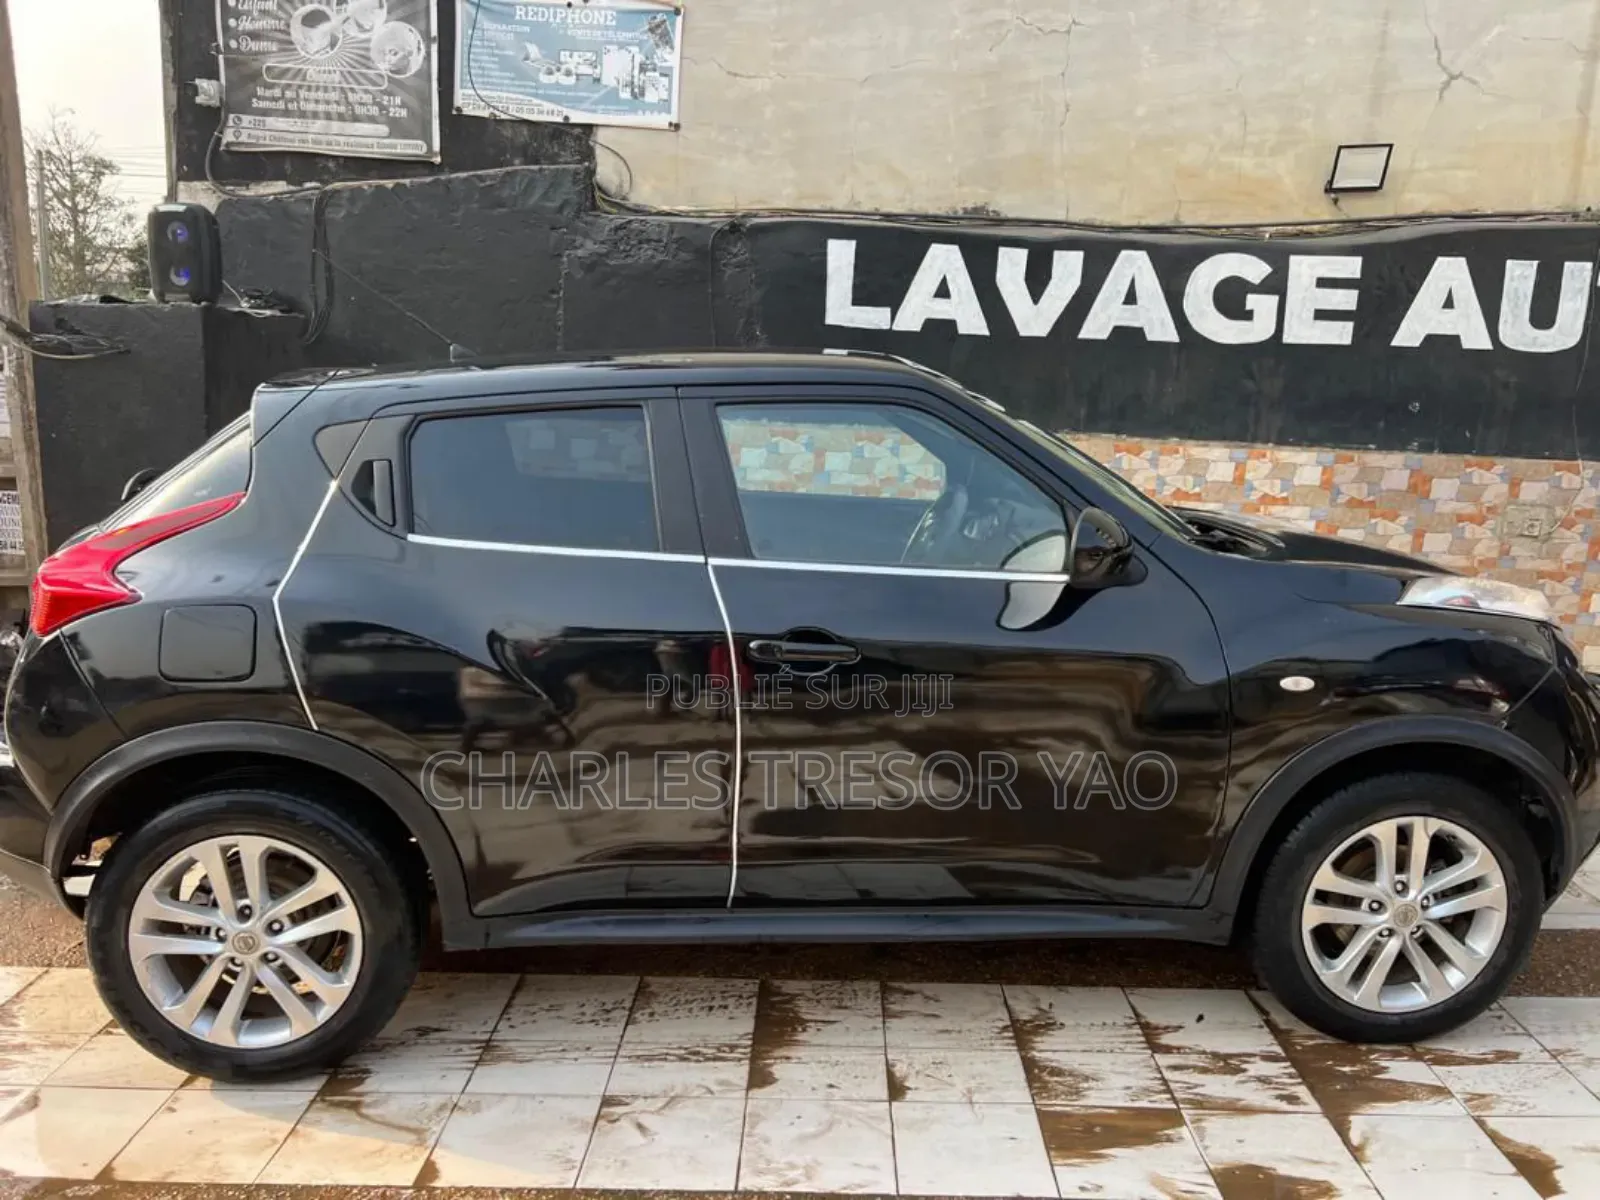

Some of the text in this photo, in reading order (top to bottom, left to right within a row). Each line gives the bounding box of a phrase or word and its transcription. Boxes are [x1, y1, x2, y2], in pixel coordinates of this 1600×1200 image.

[514, 5, 617, 26] REDIPHONE
[252, 98, 285, 110] Samedi
[299, 100, 345, 113] Dimanche
[389, 107, 408, 118] 22H
[383, 95, 402, 106] 21H
[825, 238, 1600, 353] LAVAGE AU
